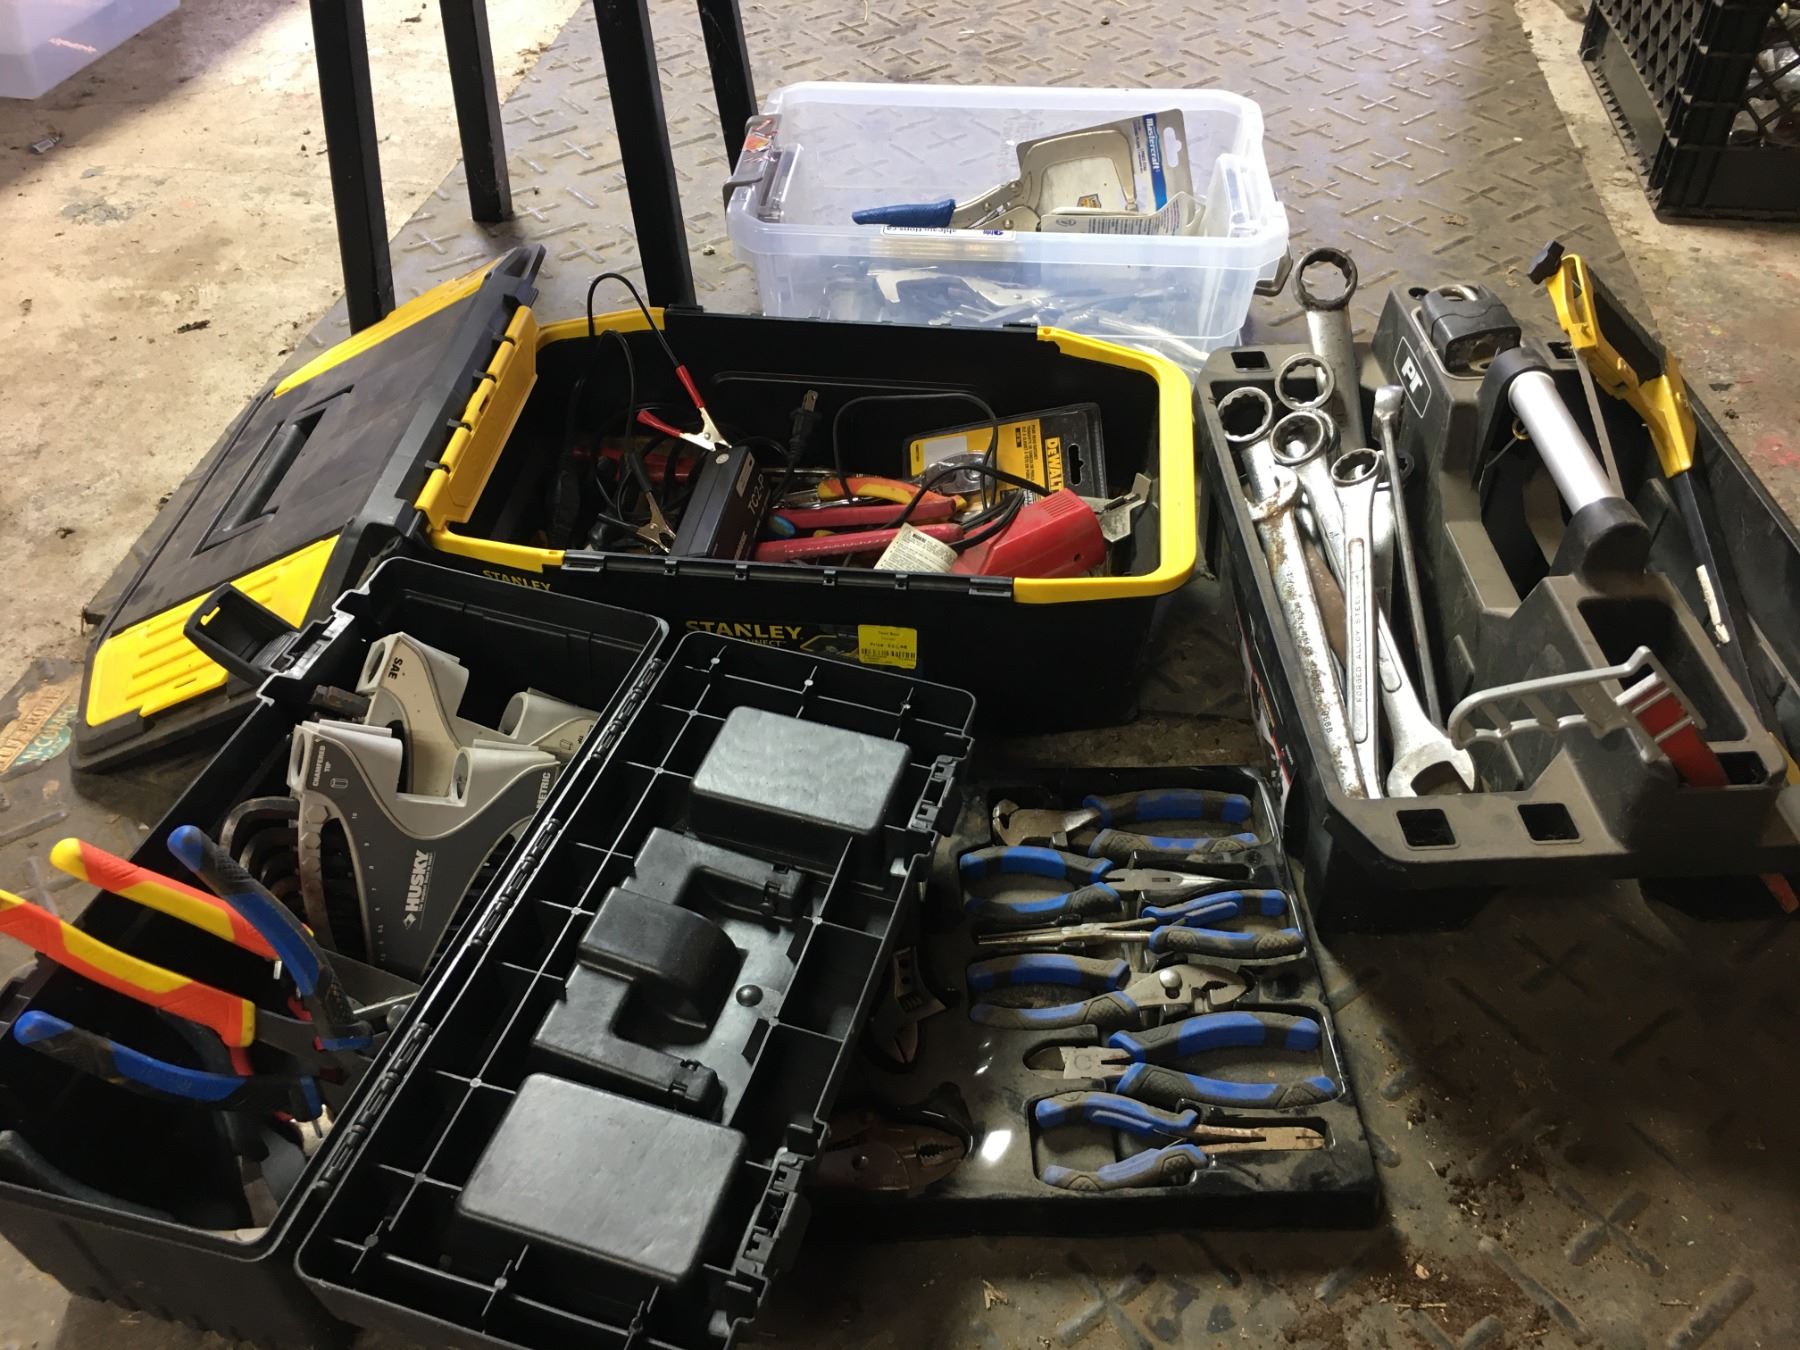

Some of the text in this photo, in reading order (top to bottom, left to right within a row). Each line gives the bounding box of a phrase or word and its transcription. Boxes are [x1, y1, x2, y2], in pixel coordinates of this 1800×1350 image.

[1145, 118, 1160, 169] Mastercraft
[1046, 439, 1062, 491] DEWALT
[483, 570, 551, 592] STANLEY
[686, 621, 802, 640] STANLEY
[388, 657, 404, 680] SAE
[536, 772, 551, 809] METRIC
[405, 849, 429, 912] HUSKY
